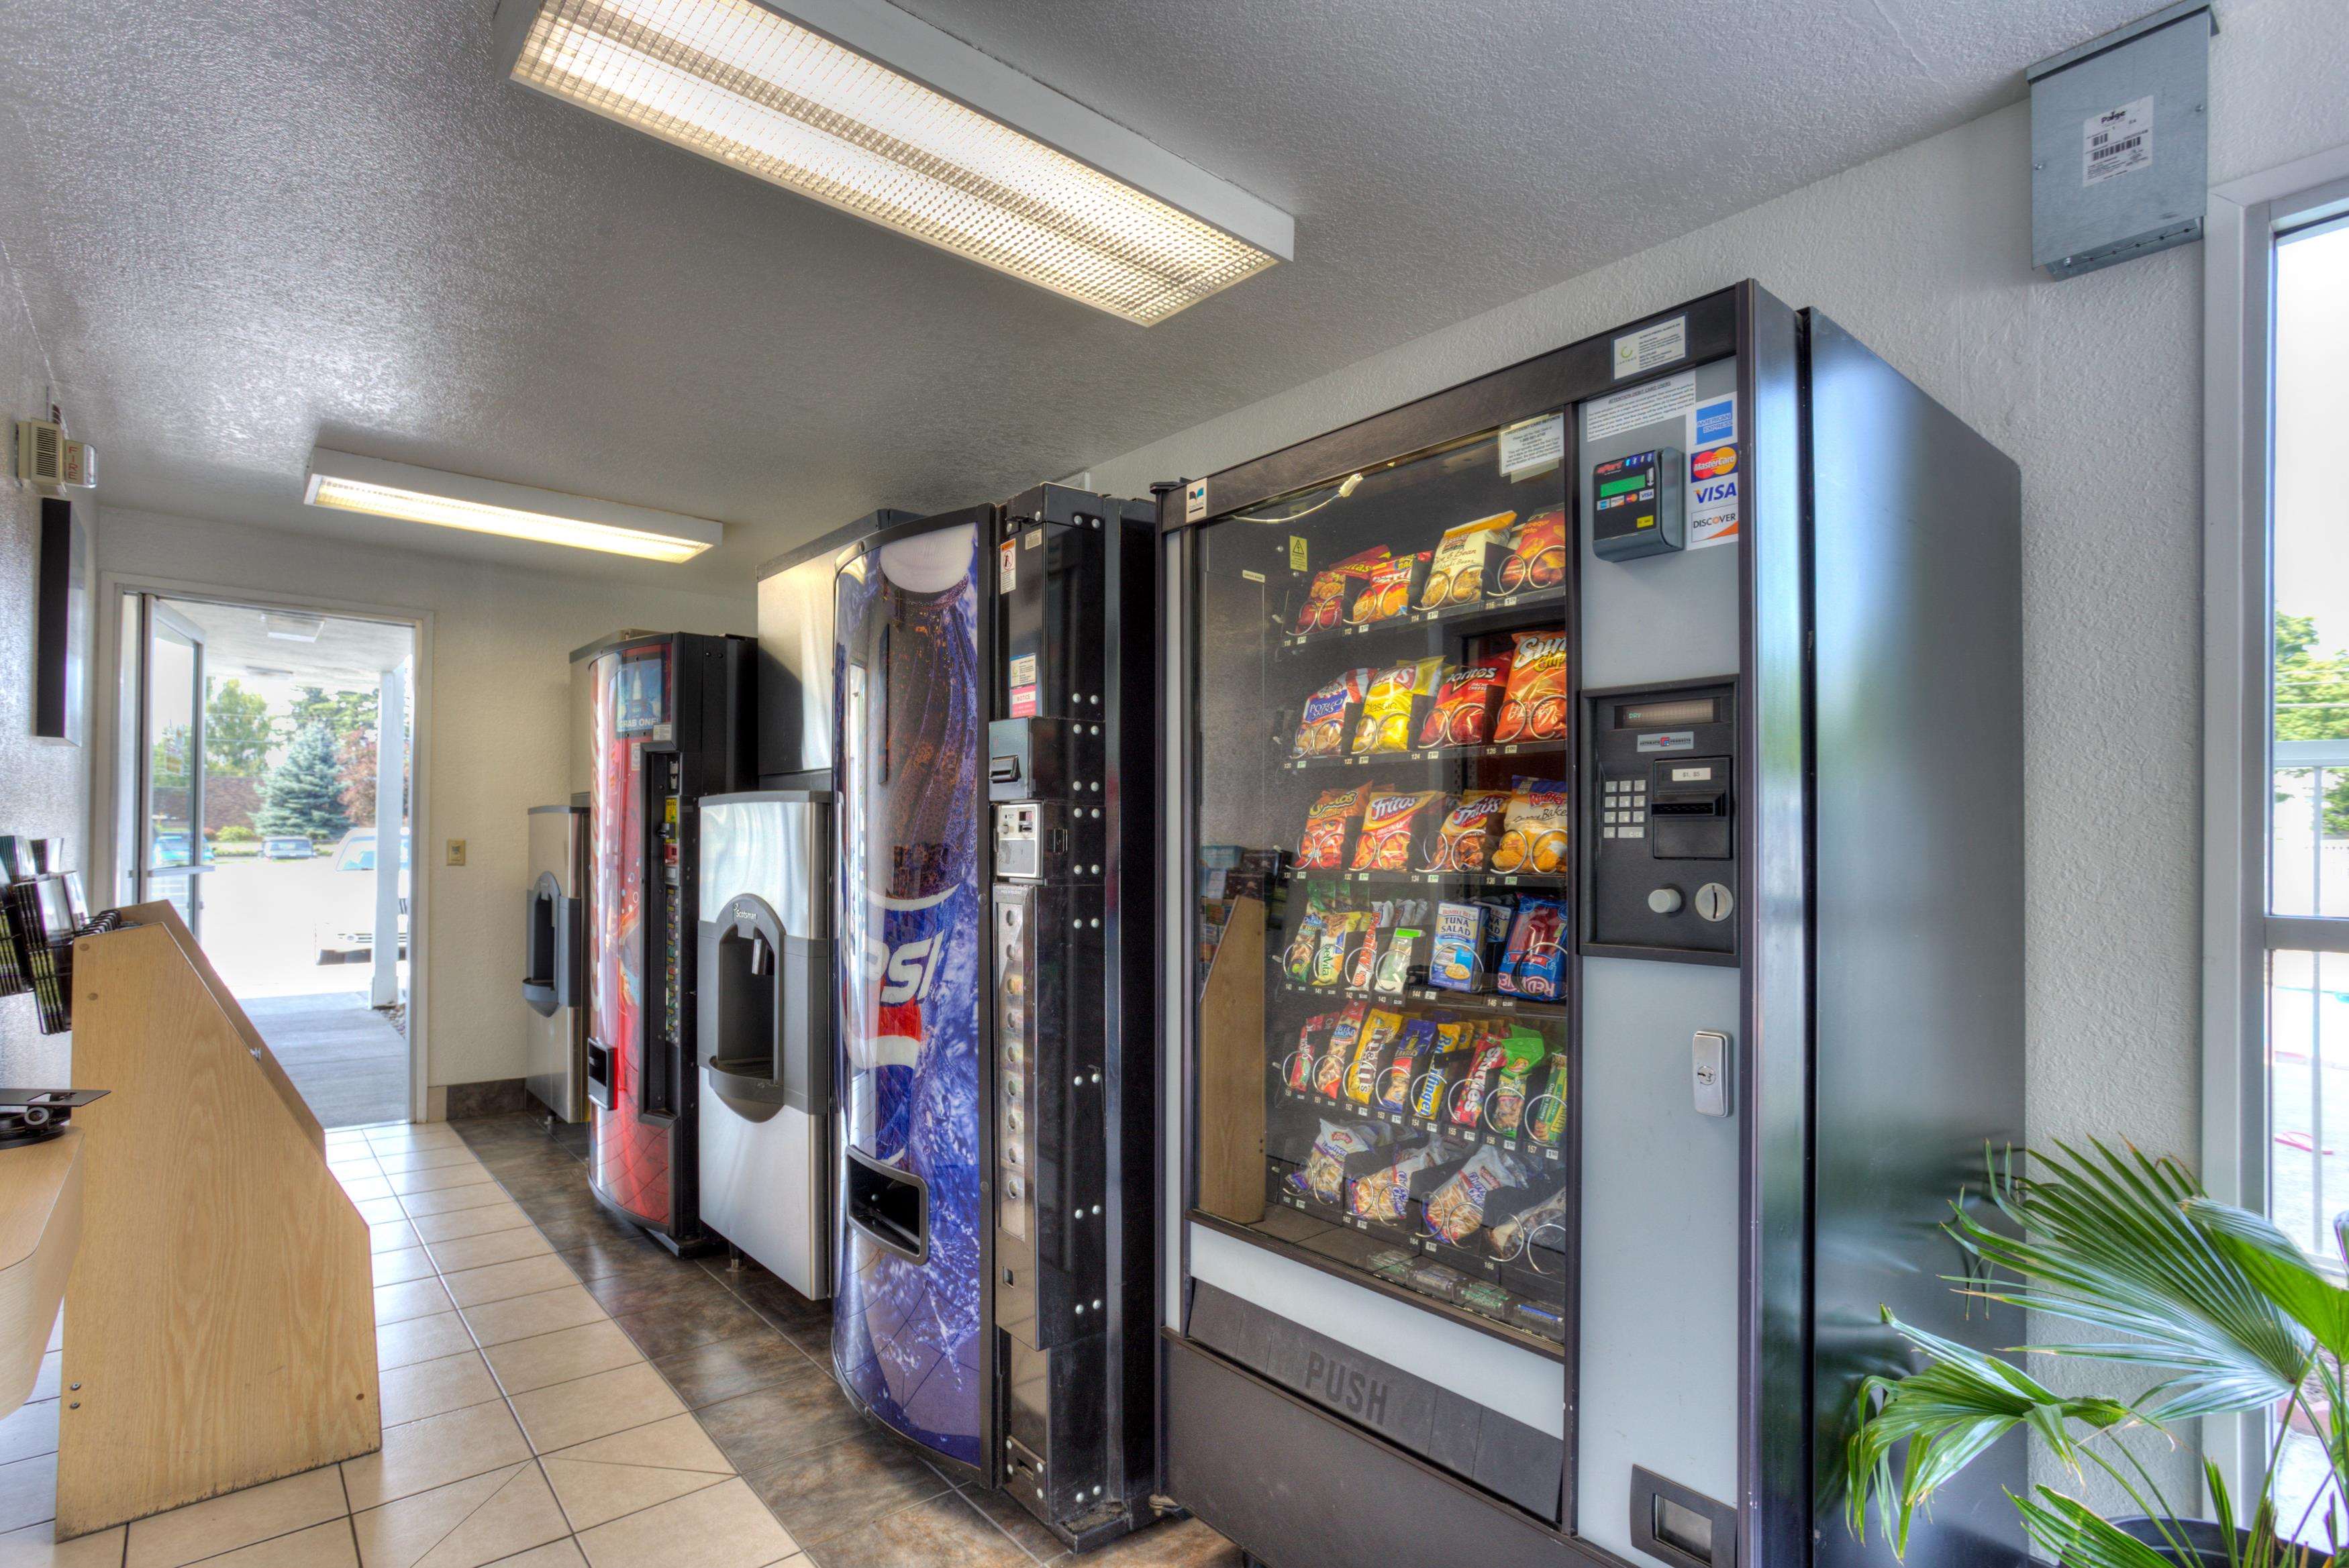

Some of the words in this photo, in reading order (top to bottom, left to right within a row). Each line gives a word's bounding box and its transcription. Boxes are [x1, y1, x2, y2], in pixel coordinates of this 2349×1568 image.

[1697, 413, 1731, 427] AMERICAN
[1703, 421, 1733, 433] EXPRESS
[1693, 455, 1737, 472] MasterCard
[1694, 482, 1737, 503] VISA
[1693, 513, 1736, 529] DISCOVER
[1534, 652, 1566, 672] Chip
[1371, 796, 1417, 820] Fritos
[1444, 917, 1468, 927] TUNA
[1440, 925, 1471, 937] SALAD
[1305, 1350, 1389, 1426] PUSH
